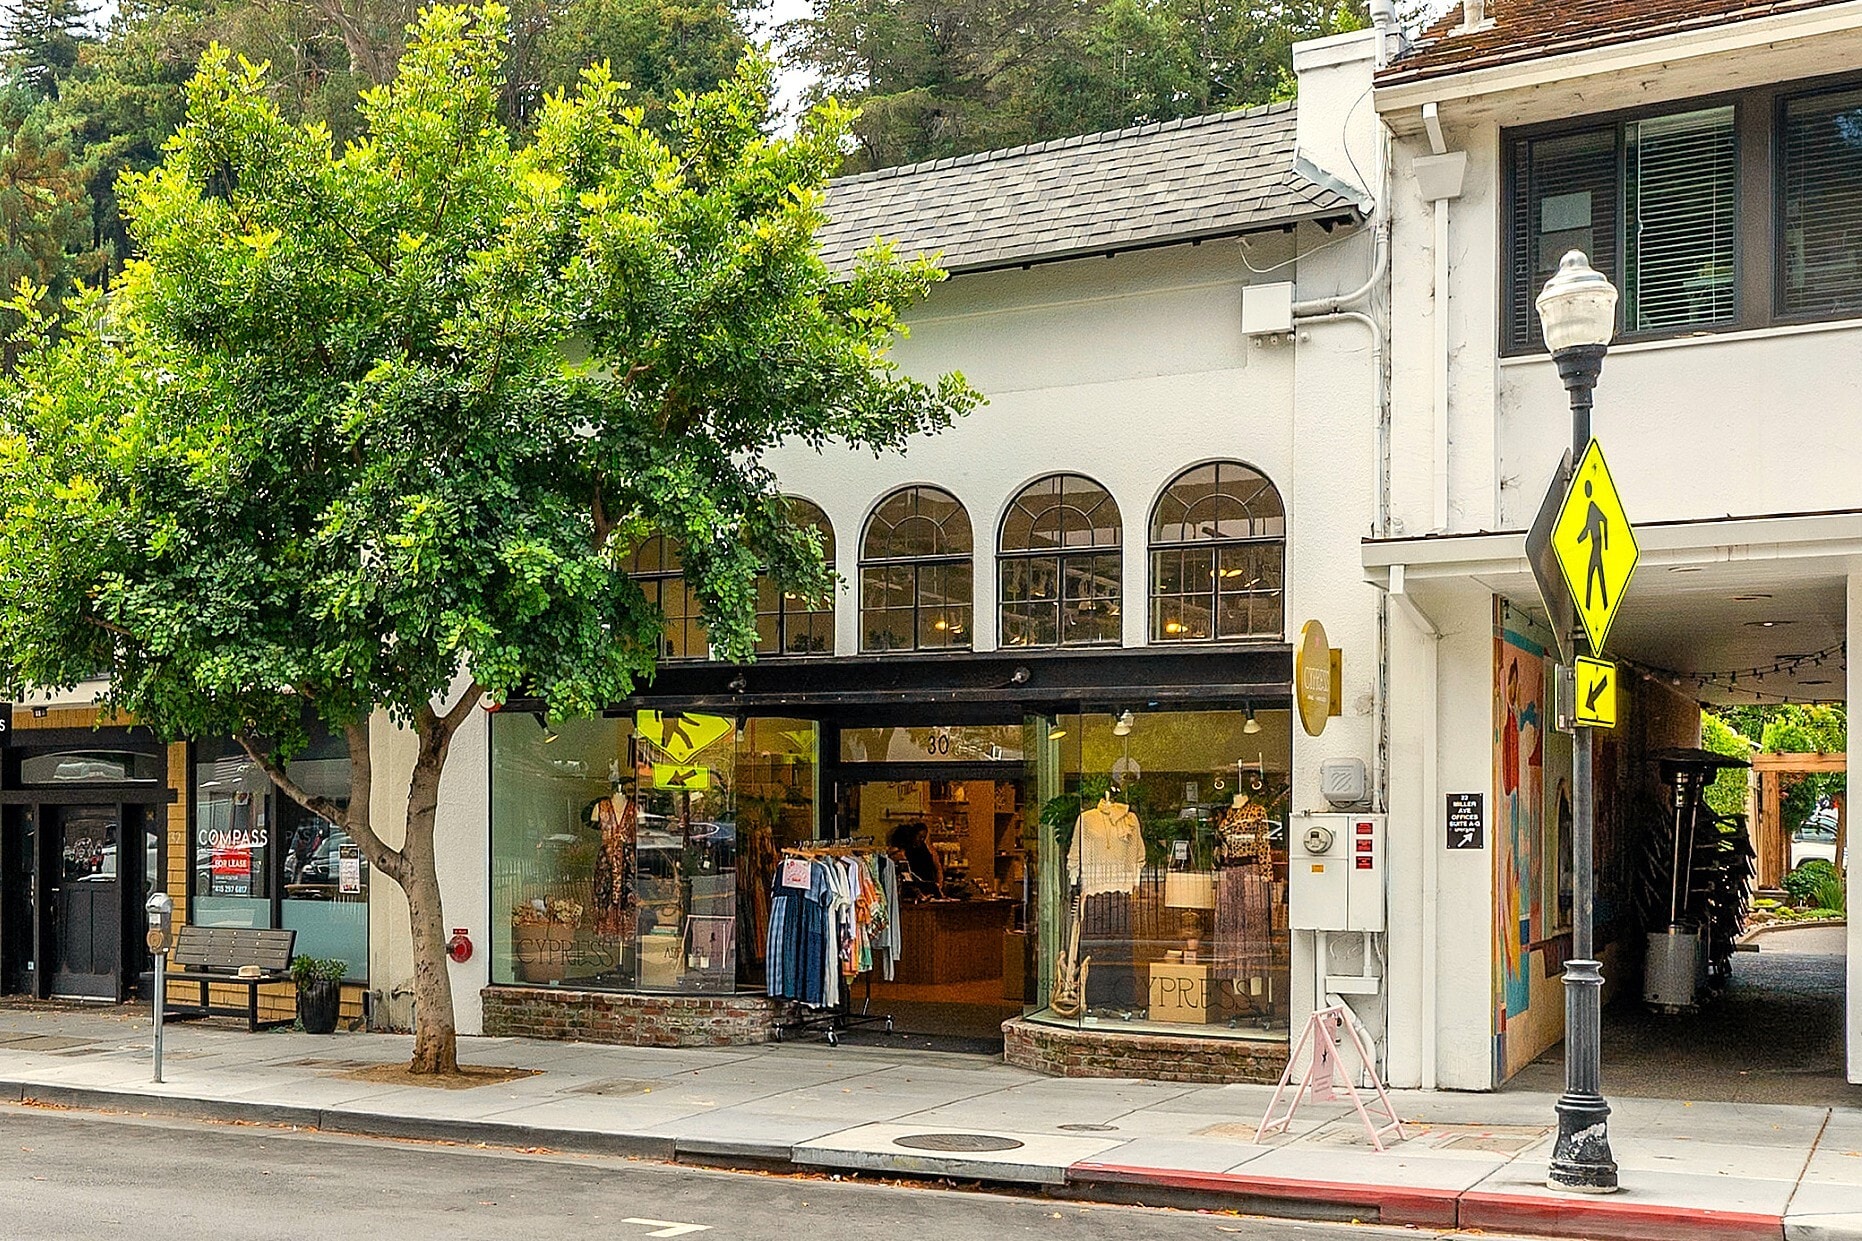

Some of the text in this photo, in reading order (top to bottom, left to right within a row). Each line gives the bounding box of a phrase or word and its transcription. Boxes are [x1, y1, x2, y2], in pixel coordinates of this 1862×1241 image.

[928, 735, 949, 755] 30
[198, 828, 268, 846] COMPASS
[214, 859, 248, 868] FOR LEASE
[517, 938, 615, 968] CYPRESS
[1114, 975, 1255, 1011] CYPRESS
